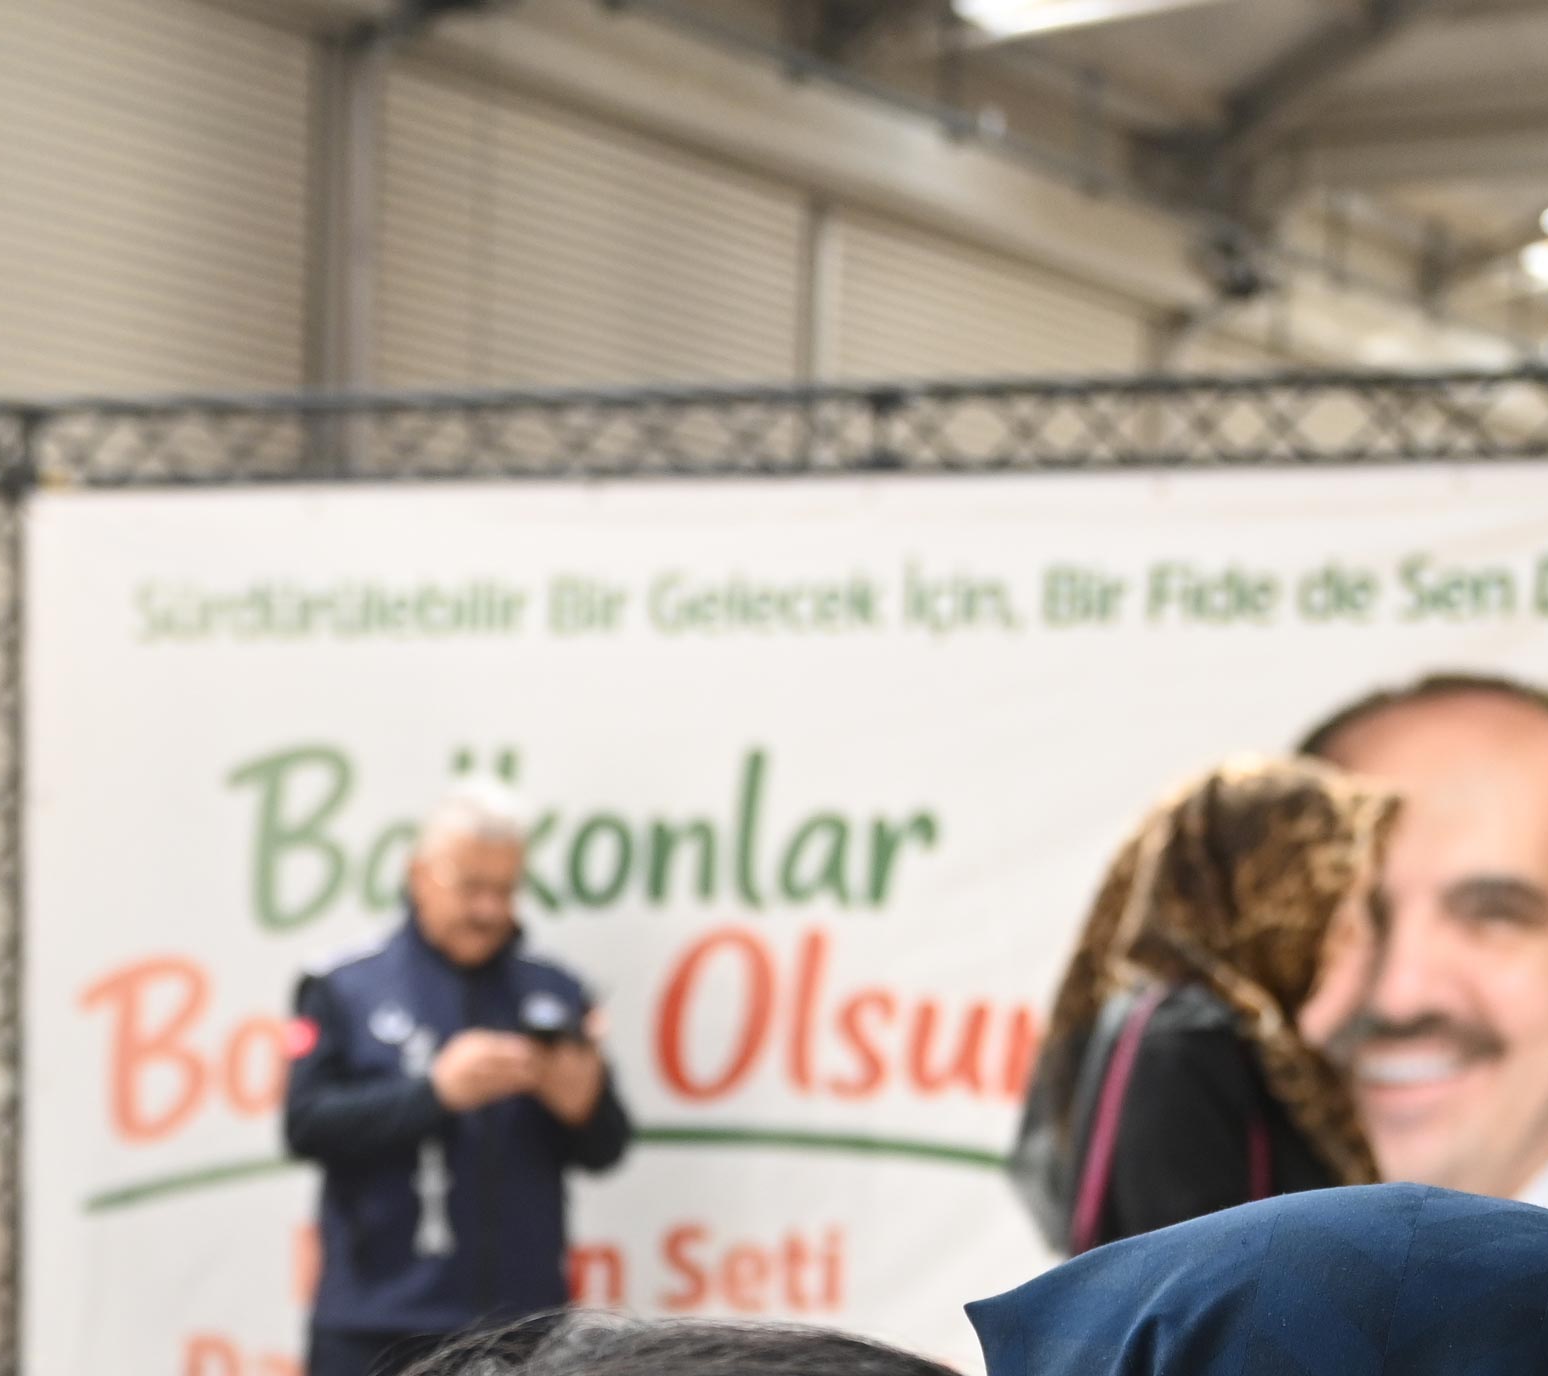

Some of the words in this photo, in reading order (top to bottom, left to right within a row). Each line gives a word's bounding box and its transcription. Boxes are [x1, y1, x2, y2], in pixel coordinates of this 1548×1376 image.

[548, 573, 626, 636] Bir
[648, 567, 881, 638] Gelecek
[1042, 563, 1123, 627] Bir
[1148, 560, 1278, 626] Fide
[1298, 562, 1376, 625] de
[1400, 553, 1515, 620] Sen
[226, 743, 936, 934] Bakonlar
[661, 1222, 847, 1312] Seti
